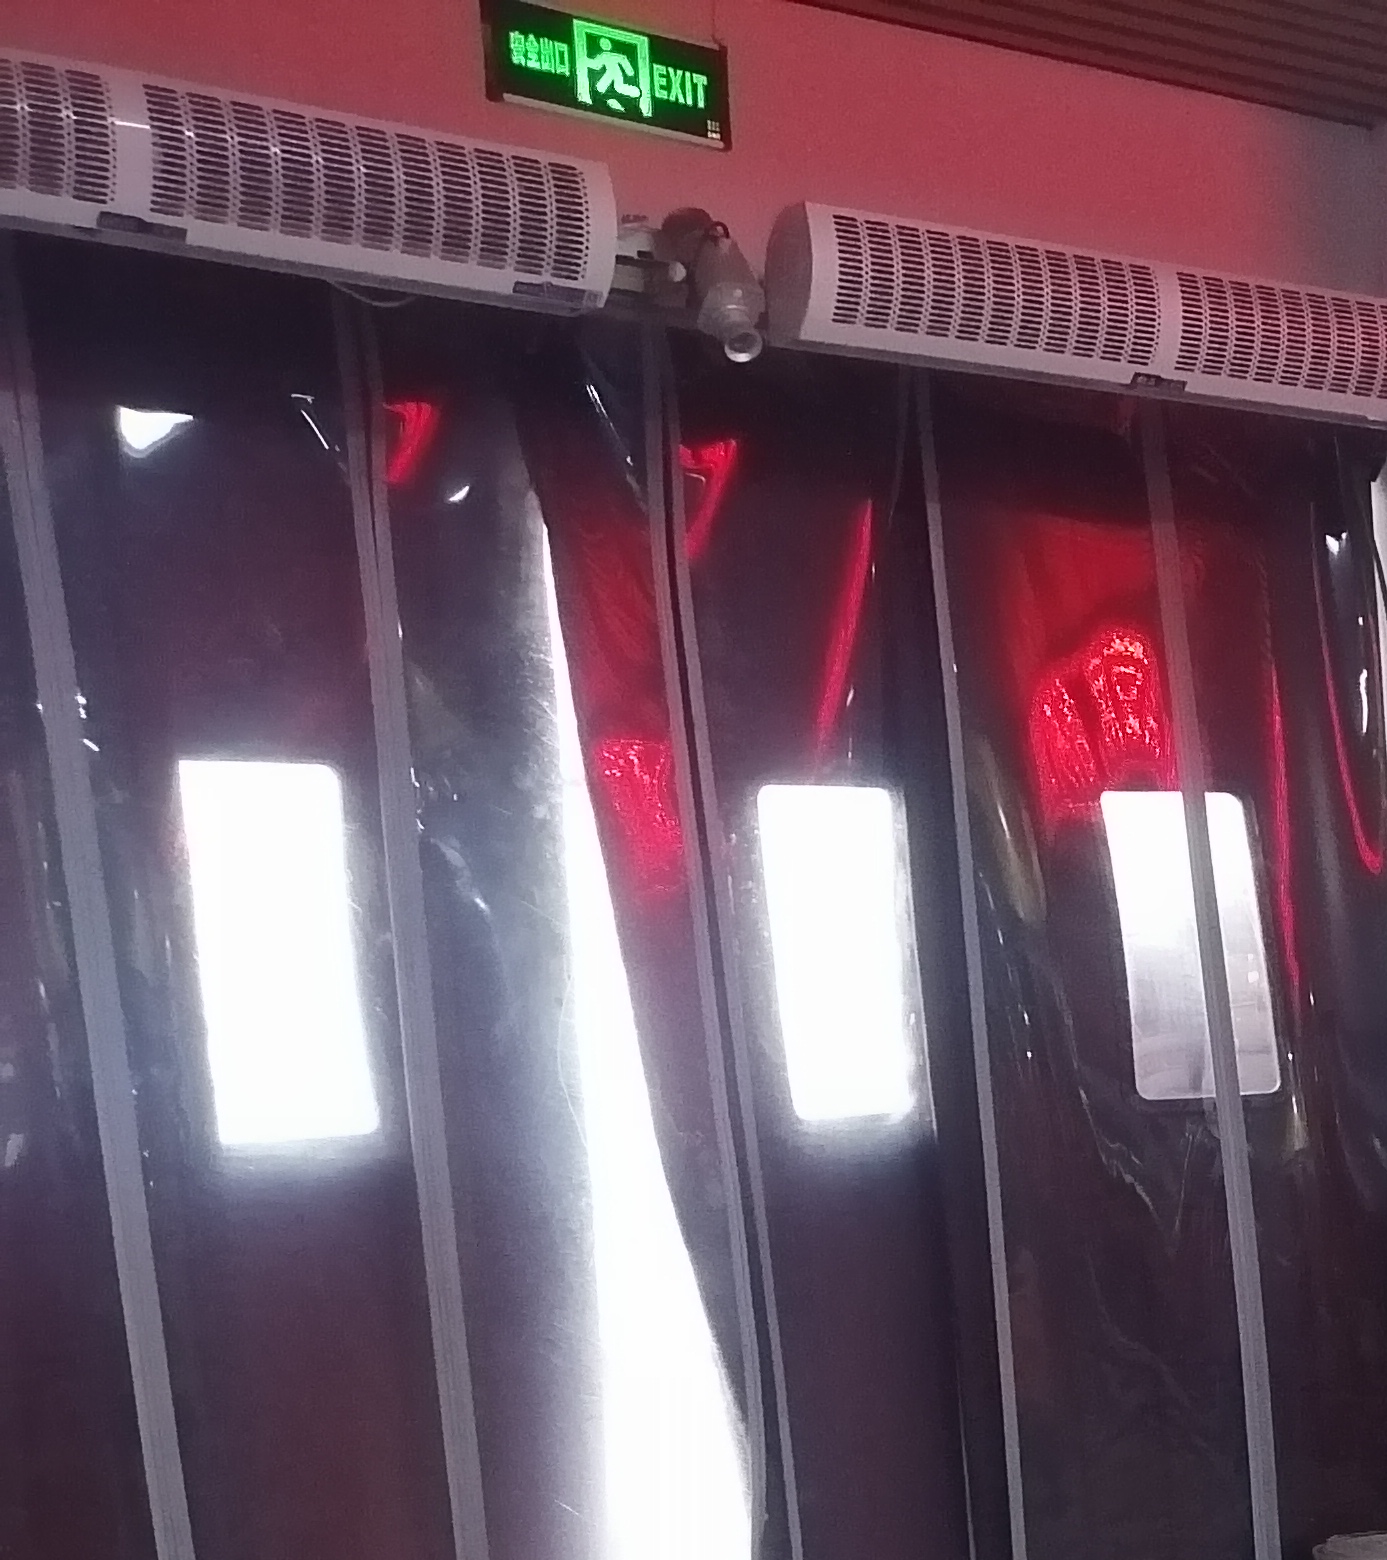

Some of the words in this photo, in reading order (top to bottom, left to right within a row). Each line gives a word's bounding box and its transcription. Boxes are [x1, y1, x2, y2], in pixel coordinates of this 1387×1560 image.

[509, 30, 570, 77] 安全出口
[652, 63, 708, 109] EXIT
